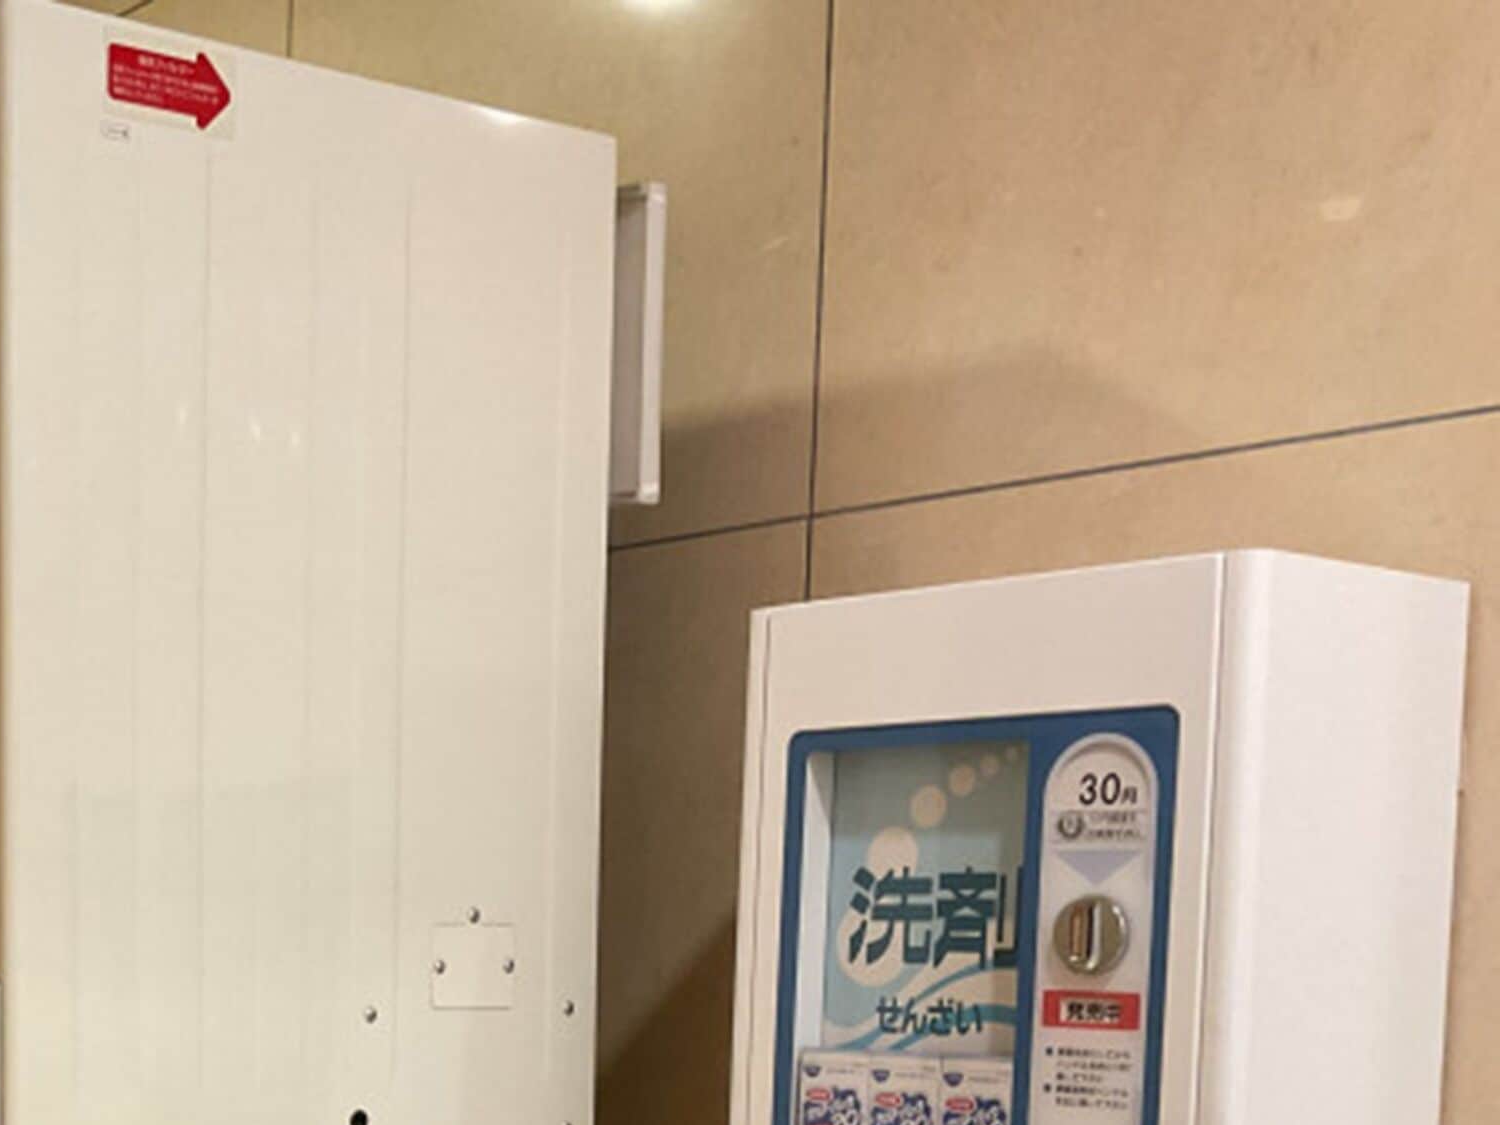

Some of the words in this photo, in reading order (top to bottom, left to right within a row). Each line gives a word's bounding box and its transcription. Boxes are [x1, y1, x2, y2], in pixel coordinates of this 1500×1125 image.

[848, 866, 1023, 968] 洗剤
[876, 996, 983, 1036] せんざい
